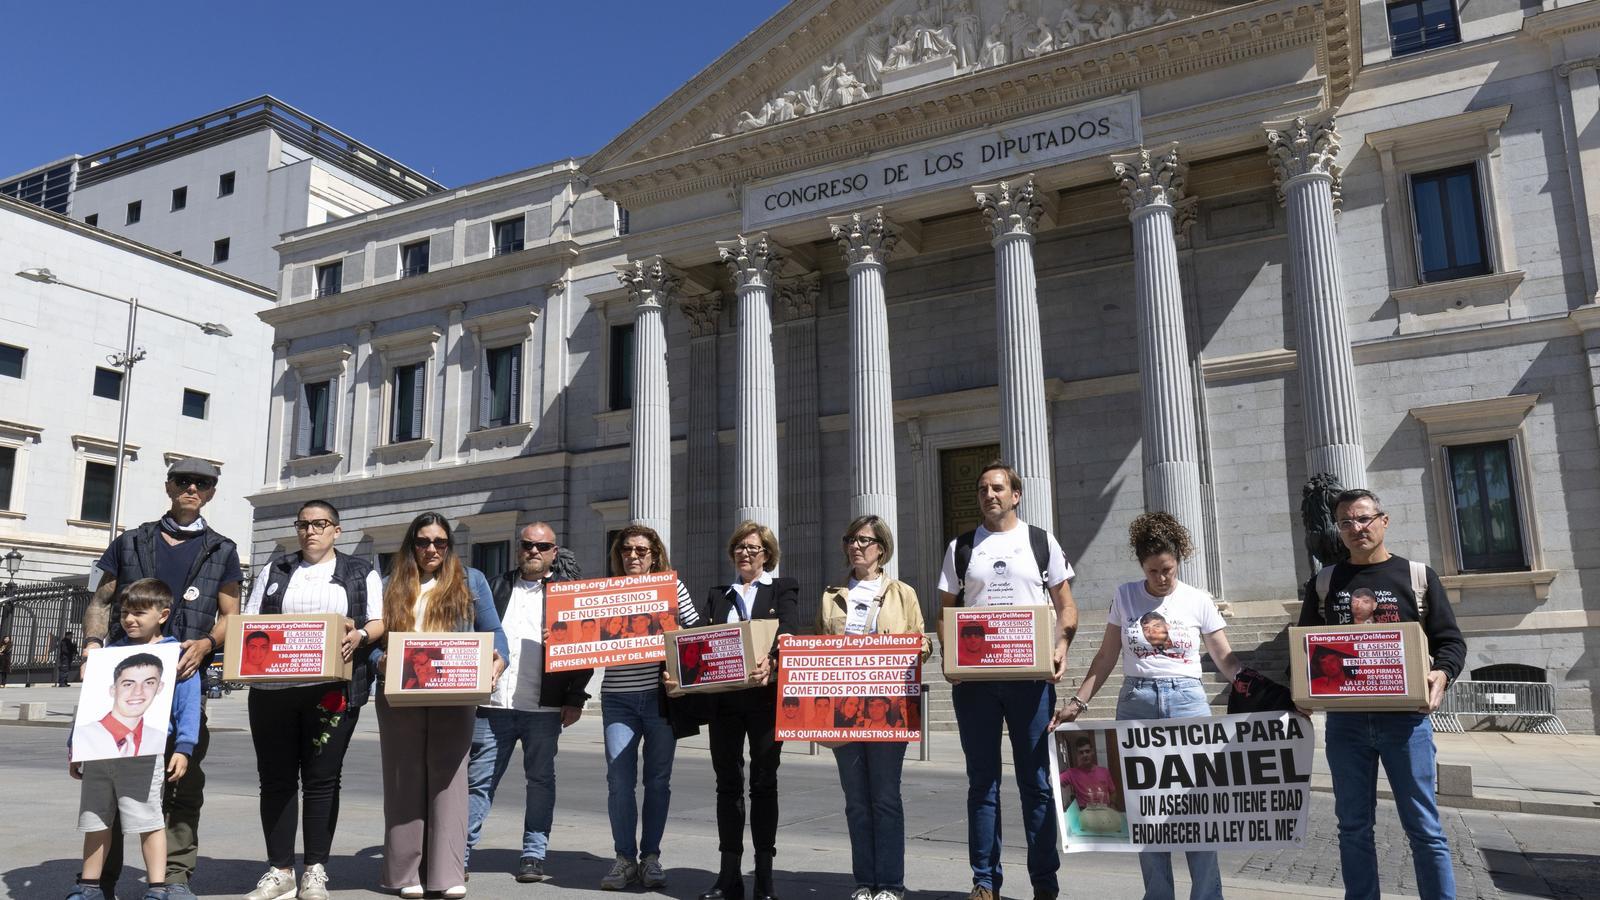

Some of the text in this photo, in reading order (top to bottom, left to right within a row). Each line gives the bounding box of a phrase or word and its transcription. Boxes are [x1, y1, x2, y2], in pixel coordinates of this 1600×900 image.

[764, 117, 1110, 211] CONGRESO DE LOS DIPUTADOS
[550, 574, 674, 592] change.org/LeyDelMenor
[580, 592, 652, 606] LOS ASESINOS
[562, 603, 665, 620] DE NUESTROS HIJOS
[1338, 613, 1351, 624] DE
[679, 631, 738, 642] change.org/LeyDelMenor
[784, 636, 918, 649] change.org/LeyDelMenor
[1310, 633, 1398, 642] change.org/LeyDelMenor
[552, 644, 591, 655] SABÍAN
[595, 642, 608, 651] LO
[610, 639, 632, 649] QUE
[550, 658, 587, 669] ¡REVISEN
[612, 654, 626, 662] LEY
[628, 652, 644, 660] DEL
[786, 655, 915, 667] ENDURECER LAS PENAS
[790, 670, 912, 681] ANTE DELITOS GRAVES
[784, 685, 919, 695] COMETIDOS POR MENORES
[779, 730, 920, 738] NOS QUITARON A NUESTROS HIJOS
[1122, 718, 1304, 749] JUSTICIA PARA
[1124, 749, 1310, 790] DANIEL
[1140, 789, 1302, 816] UN ASESINO NO TIENE EDAD
[1132, 822, 1200, 844] ENDURECER
[1205, 821, 1219, 843] LA
[1223, 821, 1244, 843] LEY
[1249, 820, 1272, 841] DEL
